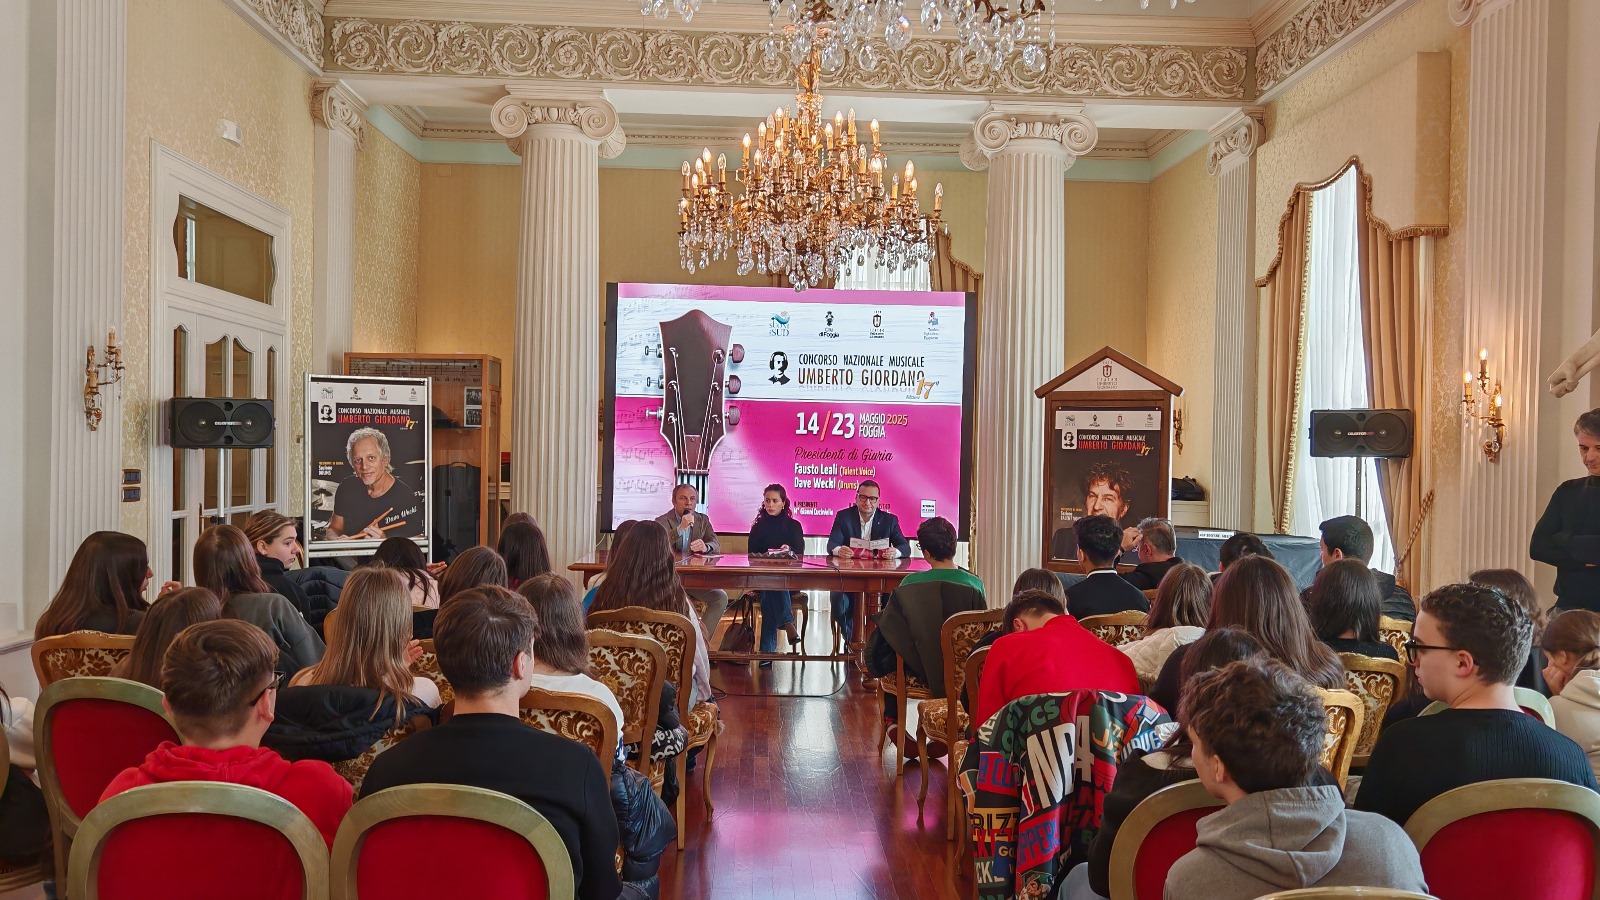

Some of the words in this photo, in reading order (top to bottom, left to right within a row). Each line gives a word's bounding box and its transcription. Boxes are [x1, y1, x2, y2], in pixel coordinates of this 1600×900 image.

[798, 353, 838, 366] CONCORSO
[843, 354, 884, 367] NAZIONALE
[888, 356, 925, 368] MUSICALE
[798, 367, 854, 386] UMBERTO
[338, 414, 371, 424] UMBERTO
[859, 412, 886, 425] MAGGIO
[886, 413, 908, 427] 2025
[858, 425, 886, 438] FOGGIA
[1078, 440, 1108, 450] UMBERTO
[794, 446, 846, 461] Presidenti
[847, 448, 859, 461] di
[861, 449, 894, 464] Giuria
[794, 462, 819, 476] Fausto
[820, 463, 838, 476] Leali
[859, 466, 876, 477] Voice)
[794, 476, 812, 488] Dave
